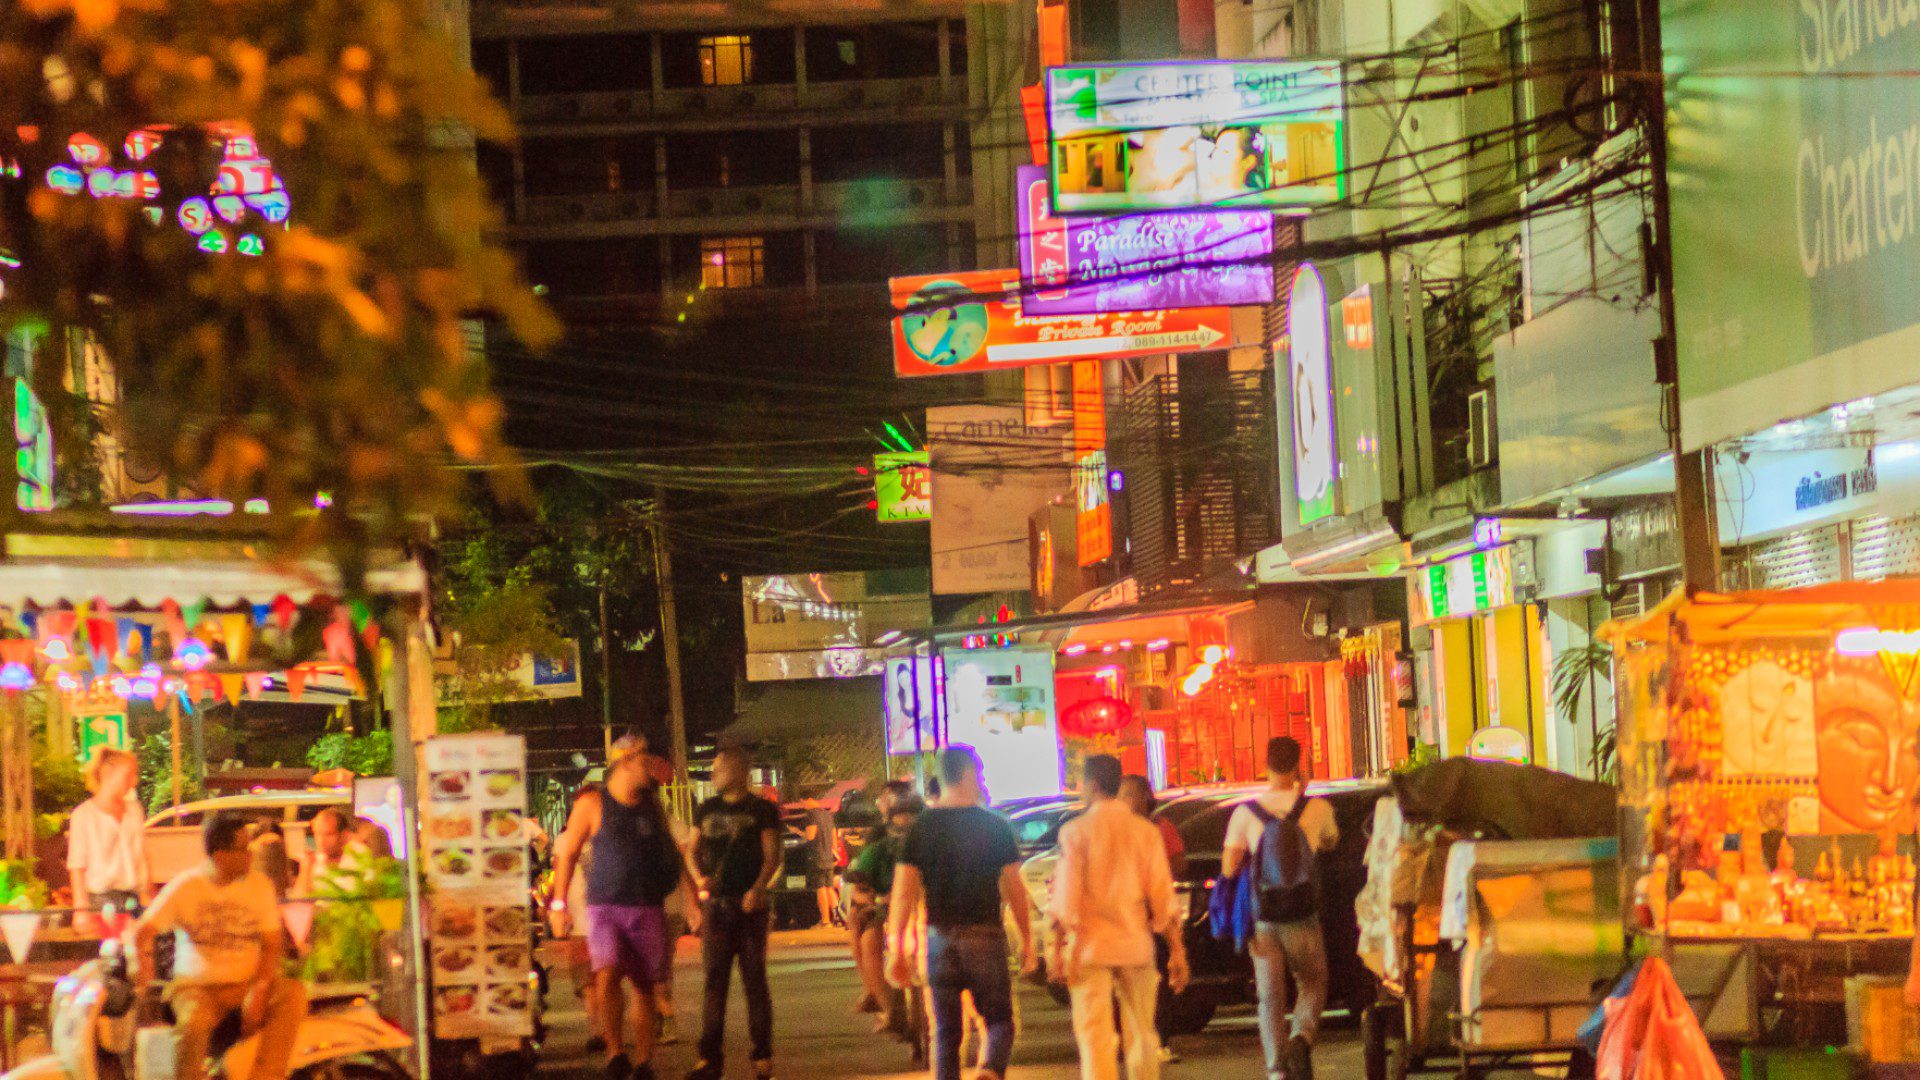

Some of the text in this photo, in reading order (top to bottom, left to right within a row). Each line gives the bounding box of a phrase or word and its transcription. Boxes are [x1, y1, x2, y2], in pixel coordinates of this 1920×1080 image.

[1233, 70, 1298, 91] POINT
[1077, 221, 1174, 252] Paradise
[1038, 322, 1104, 341] Private
[1109, 318, 1162, 338] Room
